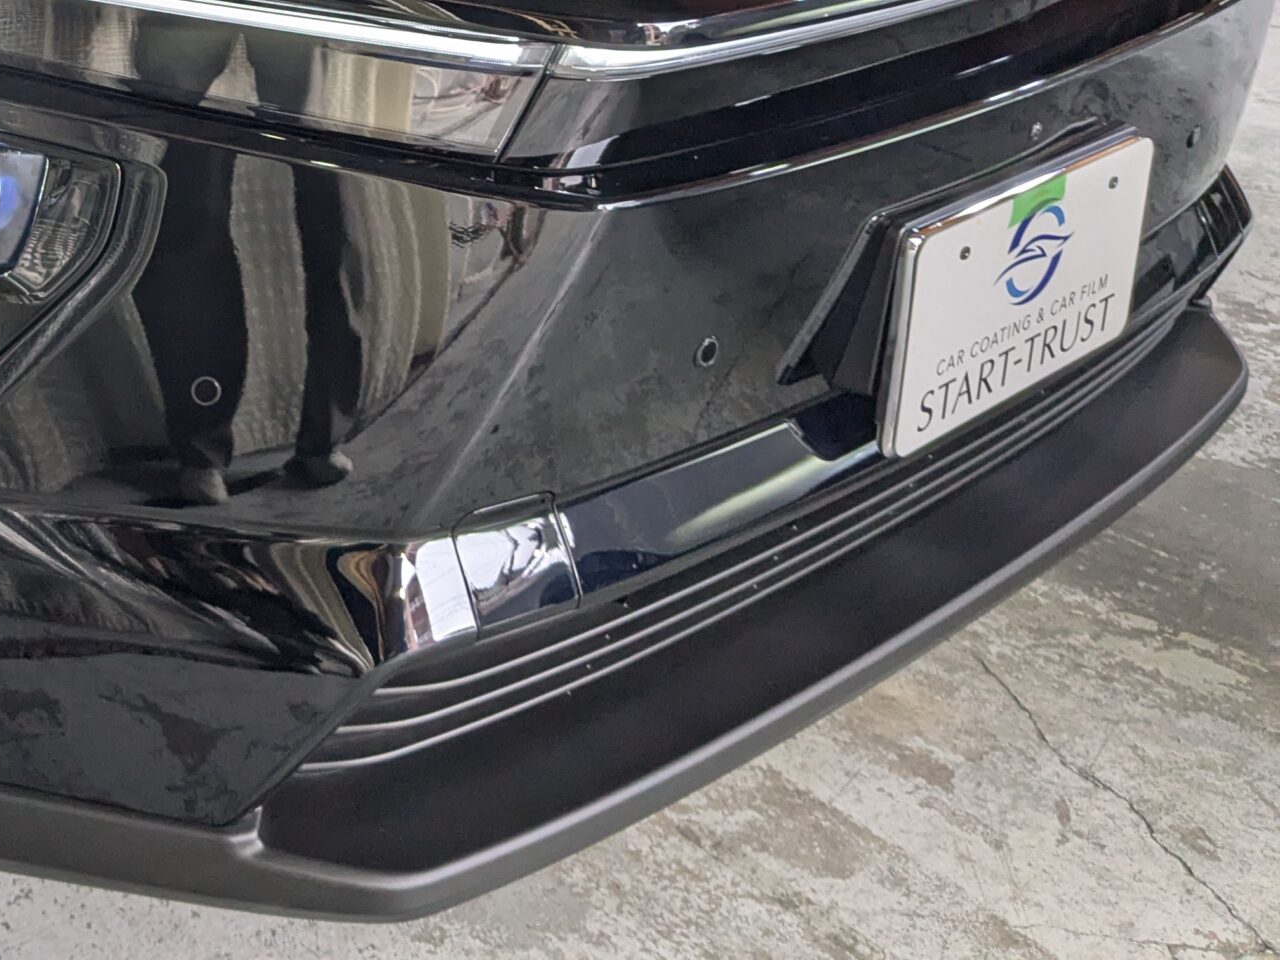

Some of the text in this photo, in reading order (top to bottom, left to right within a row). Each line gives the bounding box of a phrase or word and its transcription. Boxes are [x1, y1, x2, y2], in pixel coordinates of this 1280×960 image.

[917, 293, 1115, 432] START-TRUST
[936, 273, 1109, 376] CAR COATING & CAR FILM
